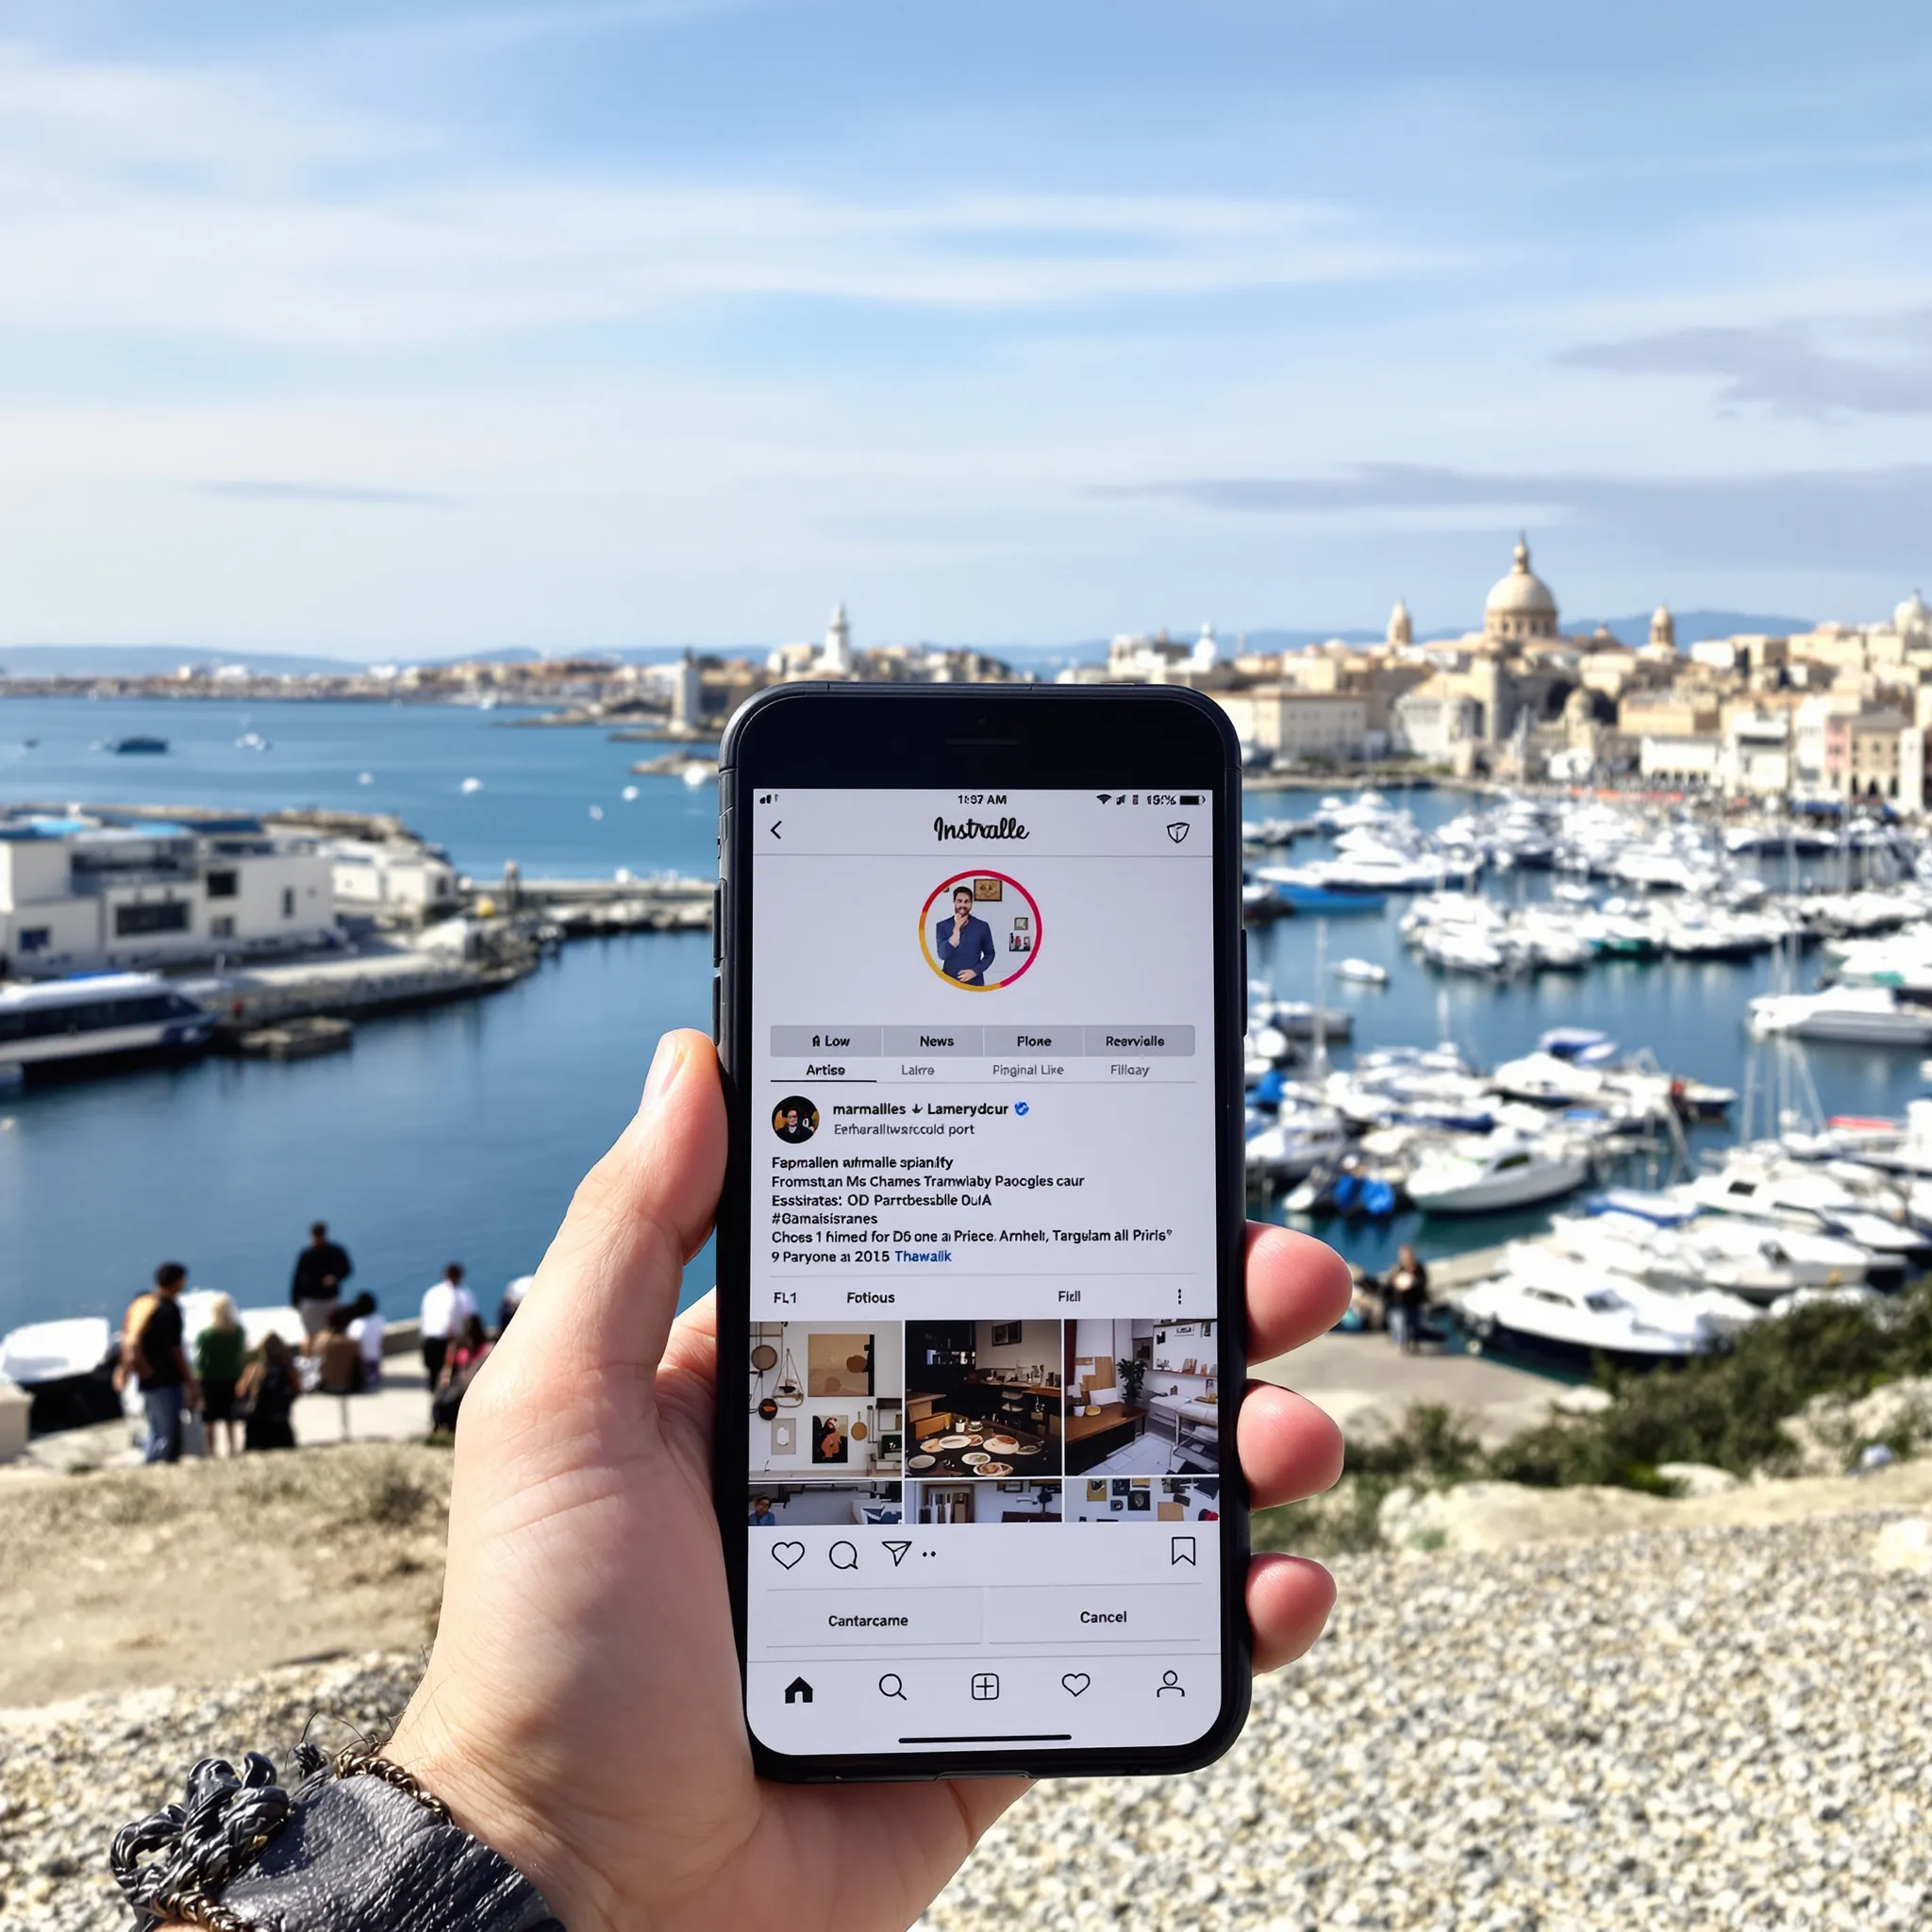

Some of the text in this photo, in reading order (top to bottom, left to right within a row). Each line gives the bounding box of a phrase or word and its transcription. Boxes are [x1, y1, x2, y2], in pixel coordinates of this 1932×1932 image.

[987, 795, 1007, 804] AM
[825, 1035, 850, 1046] Low
[921, 1036, 954, 1046] News
[949, 1124, 974, 1137] port
[847, 1175, 866, 1187] Ms
[870, 1175, 921, 1187] Chames
[848, 1194, 869, 1206] OD
[872, 1230, 890, 1242] for
[914, 1233, 938, 1241] one
[1114, 1229, 1128, 1241] all
[772, 1252, 779, 1262] 9
[855, 1250, 890, 1262] 2015
[1080, 1611, 1126, 1623] Cancel
